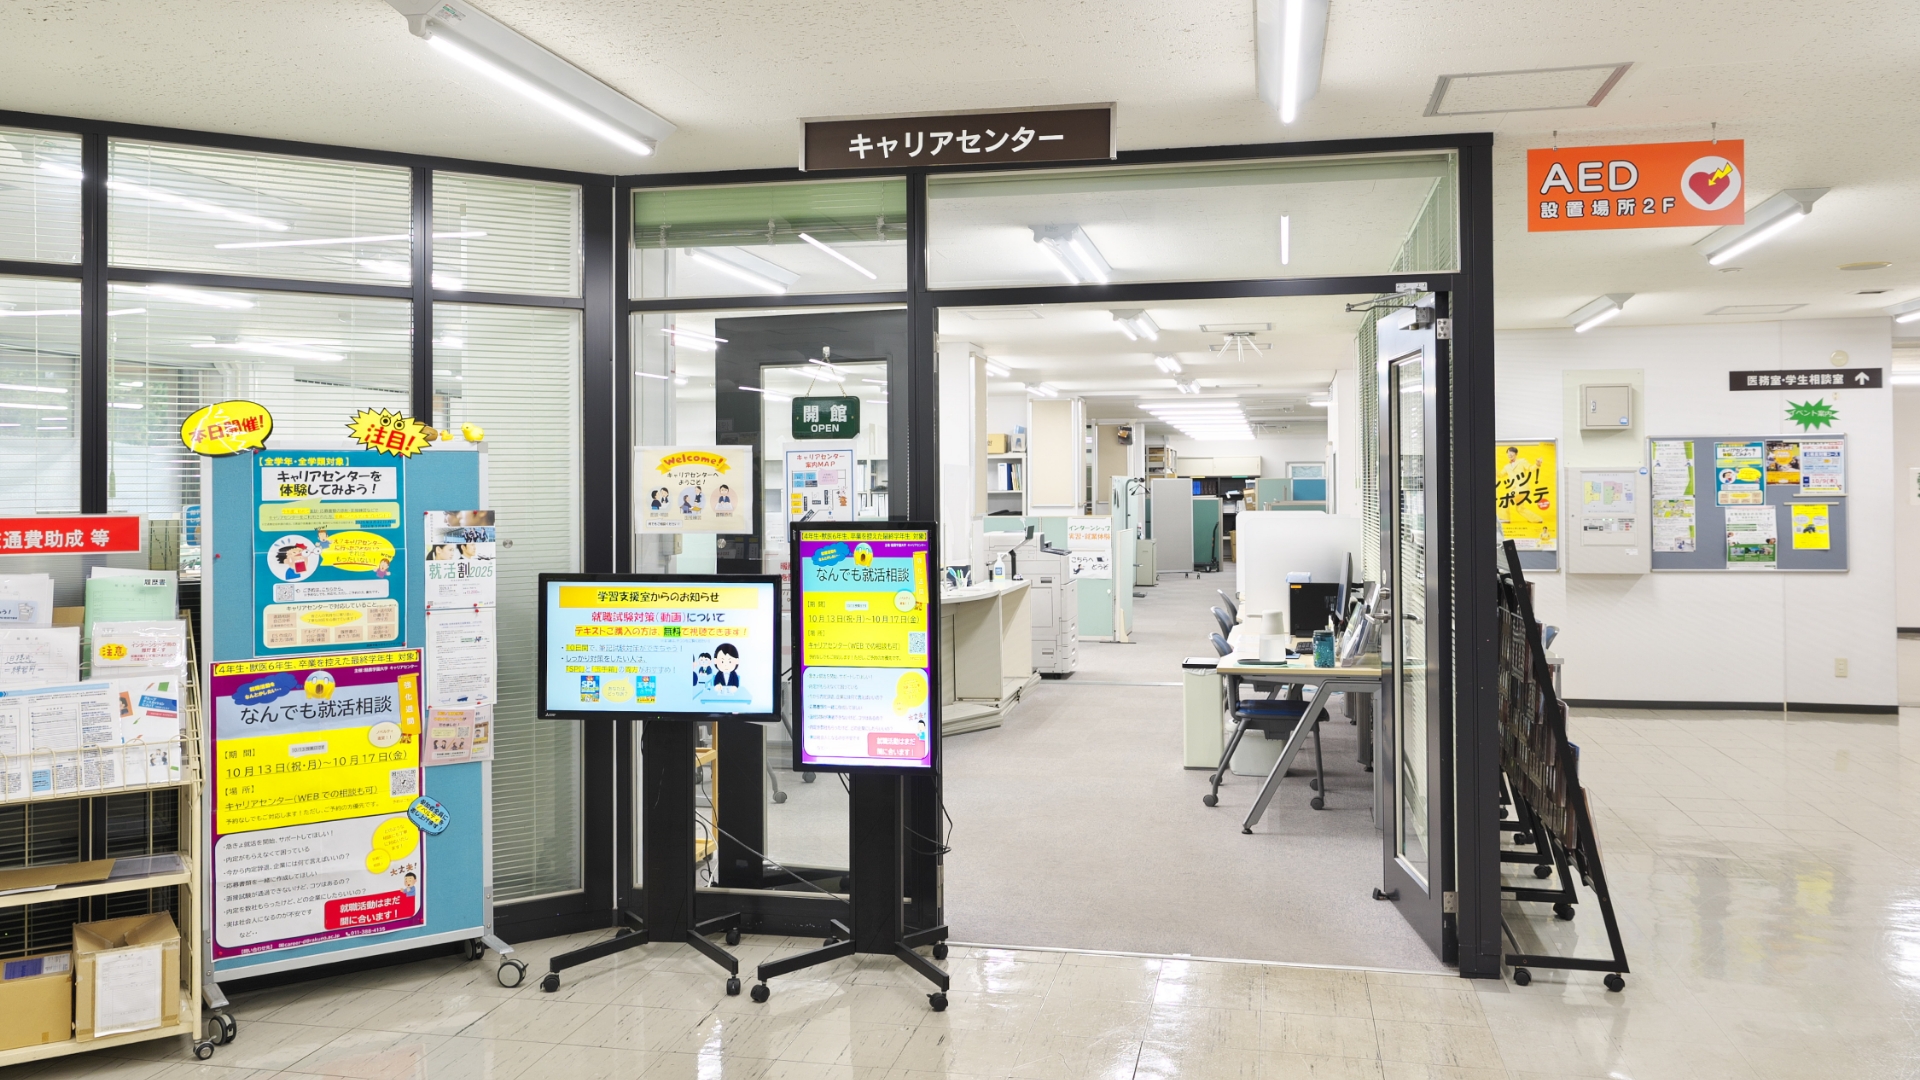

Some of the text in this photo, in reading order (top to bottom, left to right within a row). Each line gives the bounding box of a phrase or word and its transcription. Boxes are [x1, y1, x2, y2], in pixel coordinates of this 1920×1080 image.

[849, 126, 1064, 159] キャリアセンター
[1540, 160, 1639, 195] AED
[1747, 374, 1844, 386] 医務室・学生相談室
[803, 404, 847, 423] 開館
[1789, 409, 1832, 417] イベント案内
[811, 423, 840, 433] OPEN
[364, 424, 416, 451] 注目!
[663, 453, 723, 467] Welcome!
[277, 470, 382, 483] キャリアセンターを
[678, 478, 706, 486] ようこそ!
[1496, 468, 1540, 489] ッツ!
[280, 484, 377, 496] 体験してみよう!
[1496, 487, 1549, 508] ポステ
[0, 529, 110, 549] 通費助成 等
[817, 567, 910, 582] なんでも就活相談
[597, 591, 719, 602] 学習支援室からのお知らせ
[592, 611, 725, 623] 就職試験対策(動画)について
[102, 646, 125, 657] 注意
[398, 652, 419, 661] 対象】
[240, 695, 392, 725] なんでも就活相談
[390, 862, 417, 876] 大丈夫!
[340, 896, 401, 913] 就職活動はまだ
[340, 909, 398, 926] 間に合います!
